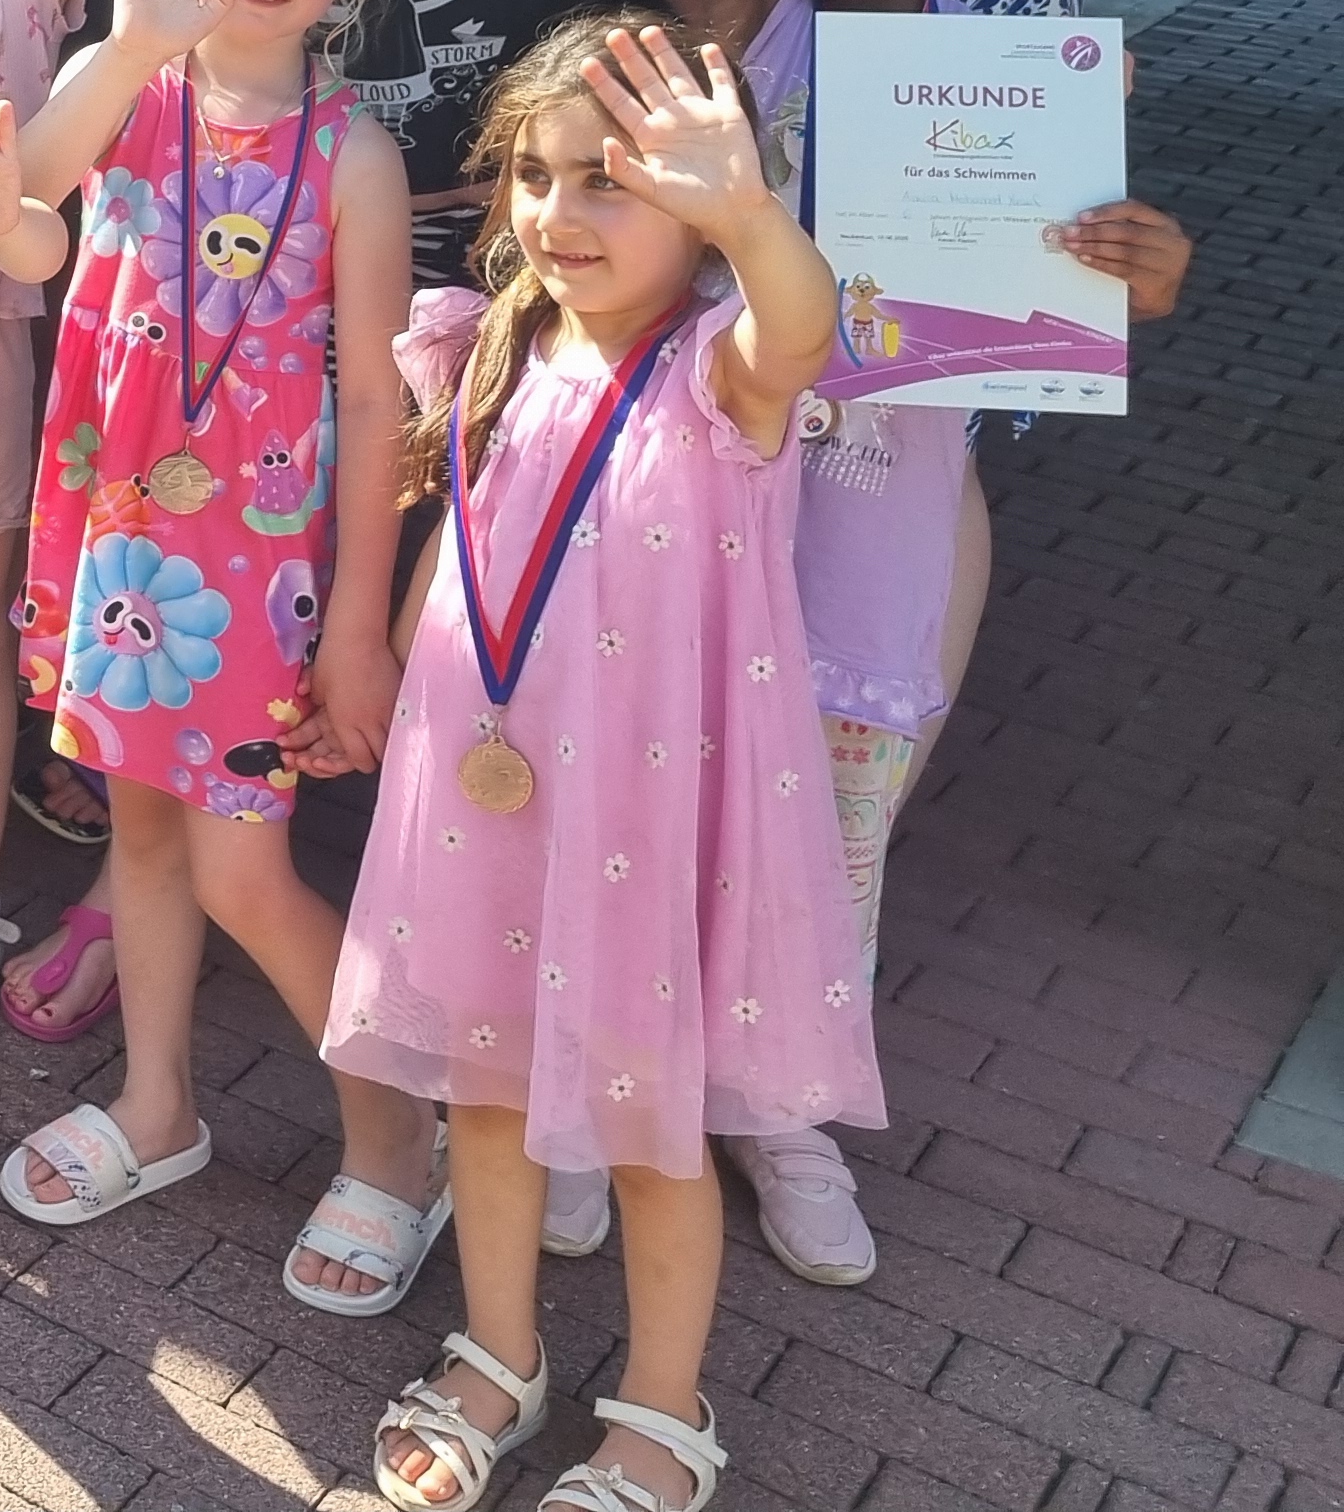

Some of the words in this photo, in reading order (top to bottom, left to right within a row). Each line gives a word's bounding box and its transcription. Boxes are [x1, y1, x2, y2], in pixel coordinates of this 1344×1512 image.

[431, 41, 494, 66] STORM
[893, 84, 1046, 109] URKUNDE
[925, 119, 1016, 153] Kibaz
[903, 165, 923, 178] für
[927, 165, 950, 178] das
[953, 167, 1036, 181] Schwimmen
